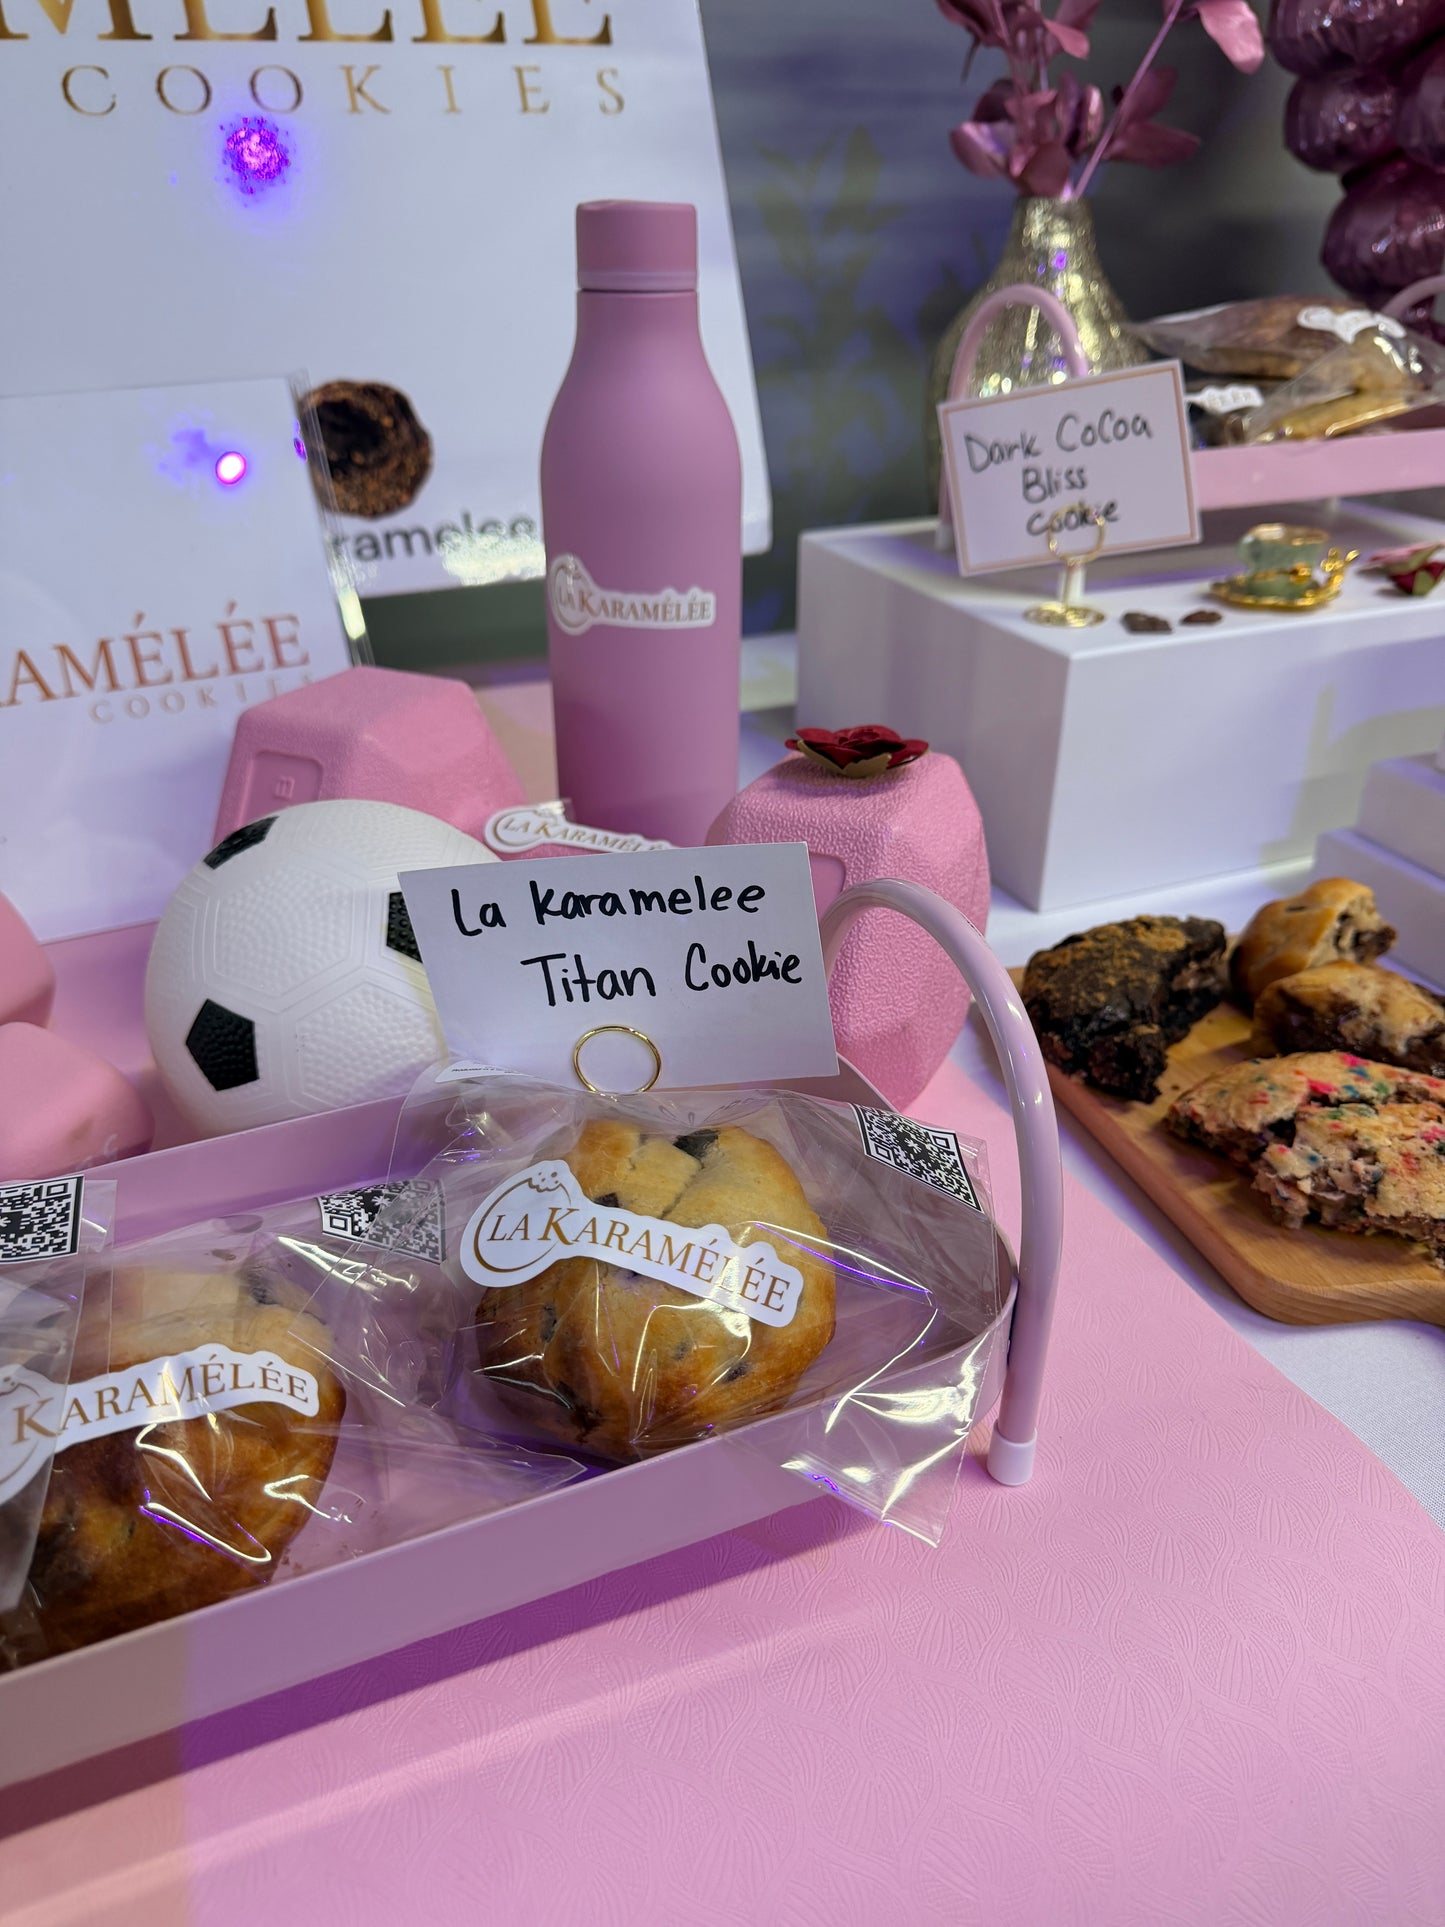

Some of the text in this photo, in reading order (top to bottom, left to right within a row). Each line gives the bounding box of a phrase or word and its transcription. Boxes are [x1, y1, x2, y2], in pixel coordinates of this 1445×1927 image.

[61, 64, 626, 117] COOKIES
[964, 431, 1041, 473] Dark
[1022, 464, 1088, 504] Bliss
[0, 599, 311, 707] AMÉLÉE
[451, 888, 506, 936] La
[521, 940, 804, 1006] Titan Cookie
[487, 1213, 531, 1242] LA
[11, 1354, 310, 1446] KARAMÉLÉE
